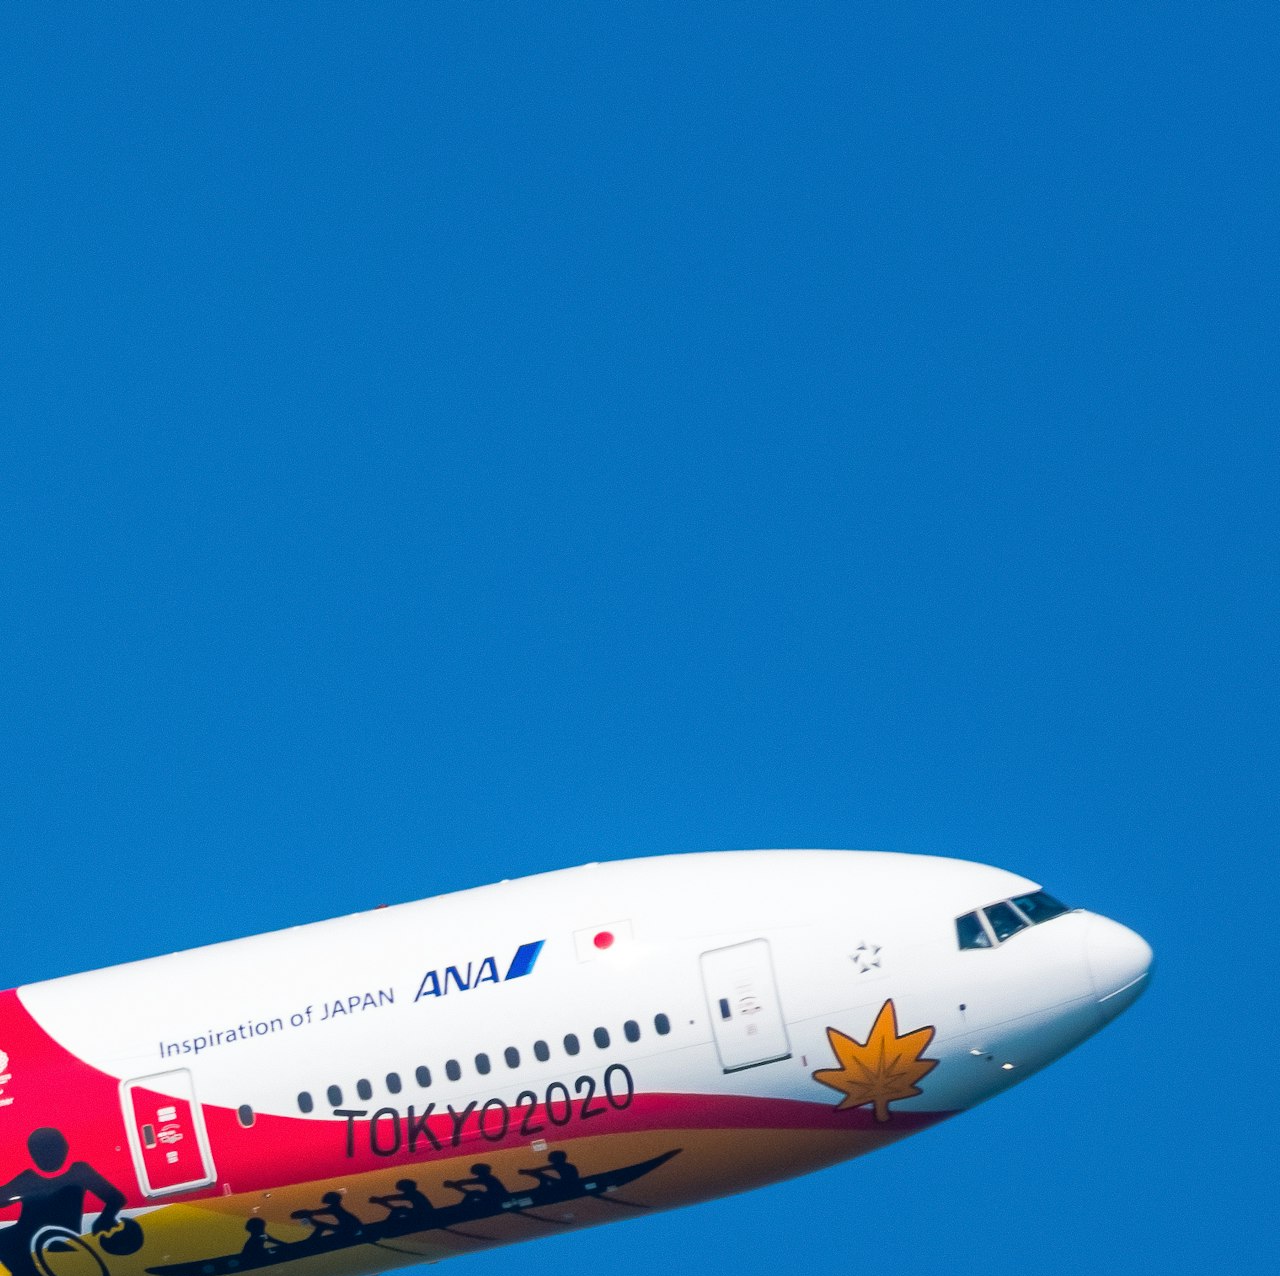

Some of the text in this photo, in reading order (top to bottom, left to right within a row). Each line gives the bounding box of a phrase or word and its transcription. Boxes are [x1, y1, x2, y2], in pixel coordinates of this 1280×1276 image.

[413, 956, 500, 1003] ANA
[159, 987, 395, 1059] Inspiration of JAPAN
